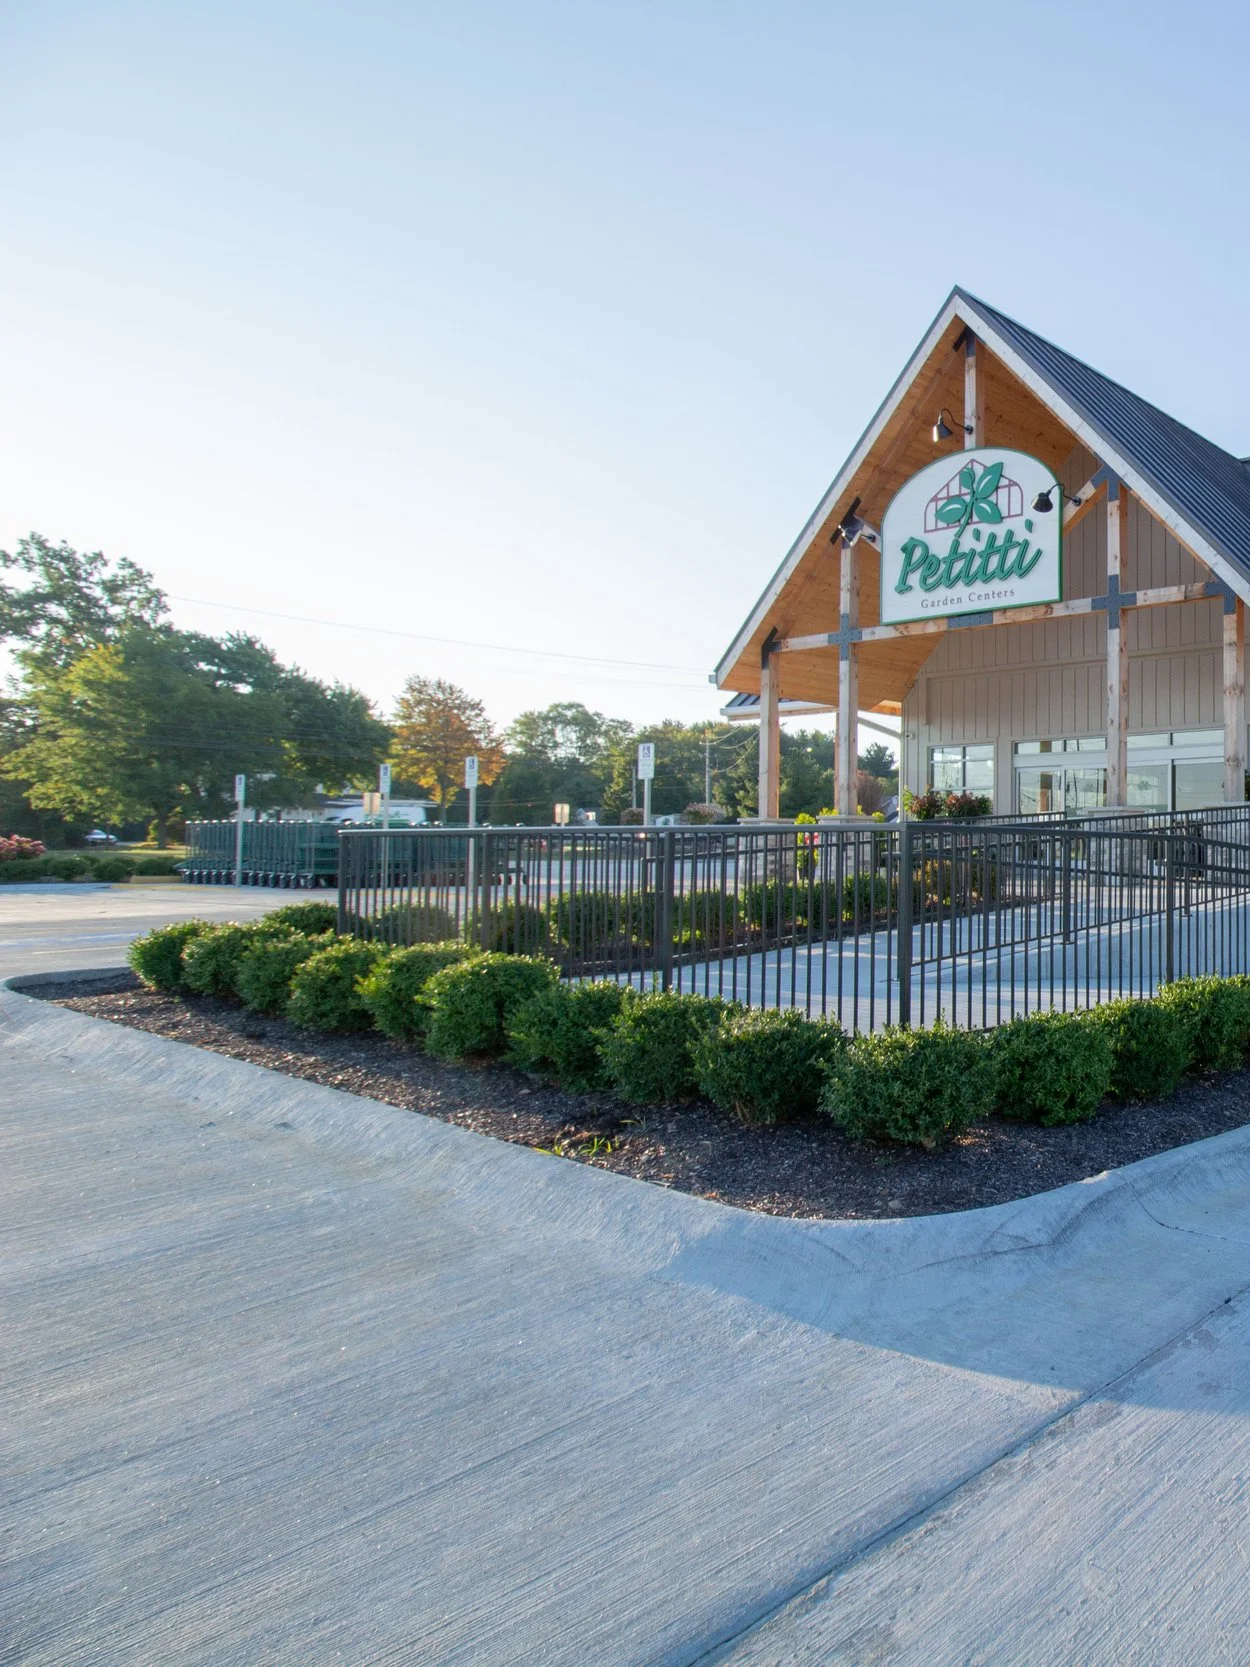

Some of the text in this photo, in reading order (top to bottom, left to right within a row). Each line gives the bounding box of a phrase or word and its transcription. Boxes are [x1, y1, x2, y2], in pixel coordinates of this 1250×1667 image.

[894, 518, 1042, 595] Petitti
[920, 588, 1015, 609] Garden Centers
